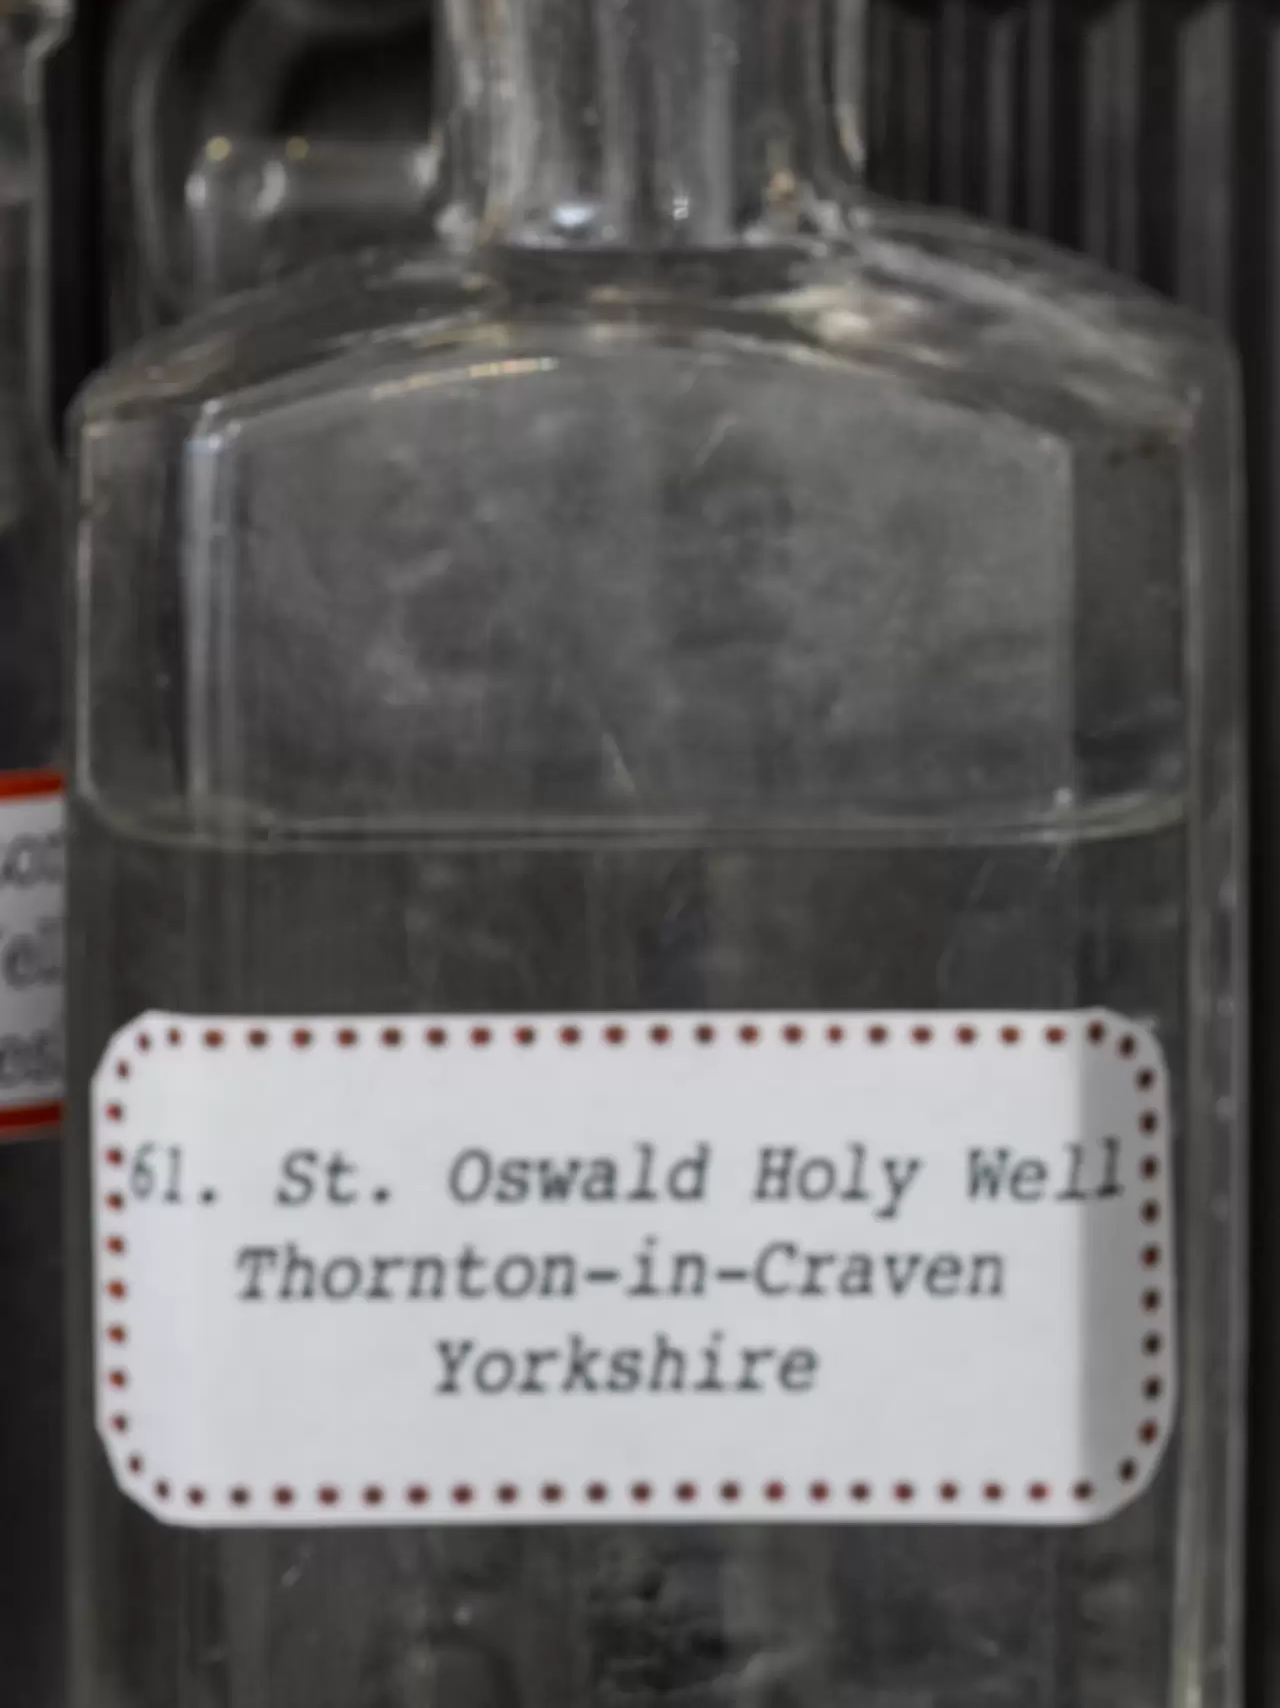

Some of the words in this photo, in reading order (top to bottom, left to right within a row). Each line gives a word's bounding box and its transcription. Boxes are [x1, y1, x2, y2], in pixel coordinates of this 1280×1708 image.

[129, 1140, 221, 1207] 61.
[275, 1149, 395, 1207] St.
[447, 1142, 709, 1207] Oswald
[752, 1144, 920, 1217] Holy
[966, 1136, 1122, 1203] Well
[236, 1241, 1005, 1303] Thornton-in-Craven
[433, 1330, 819, 1396] Yorkshire
